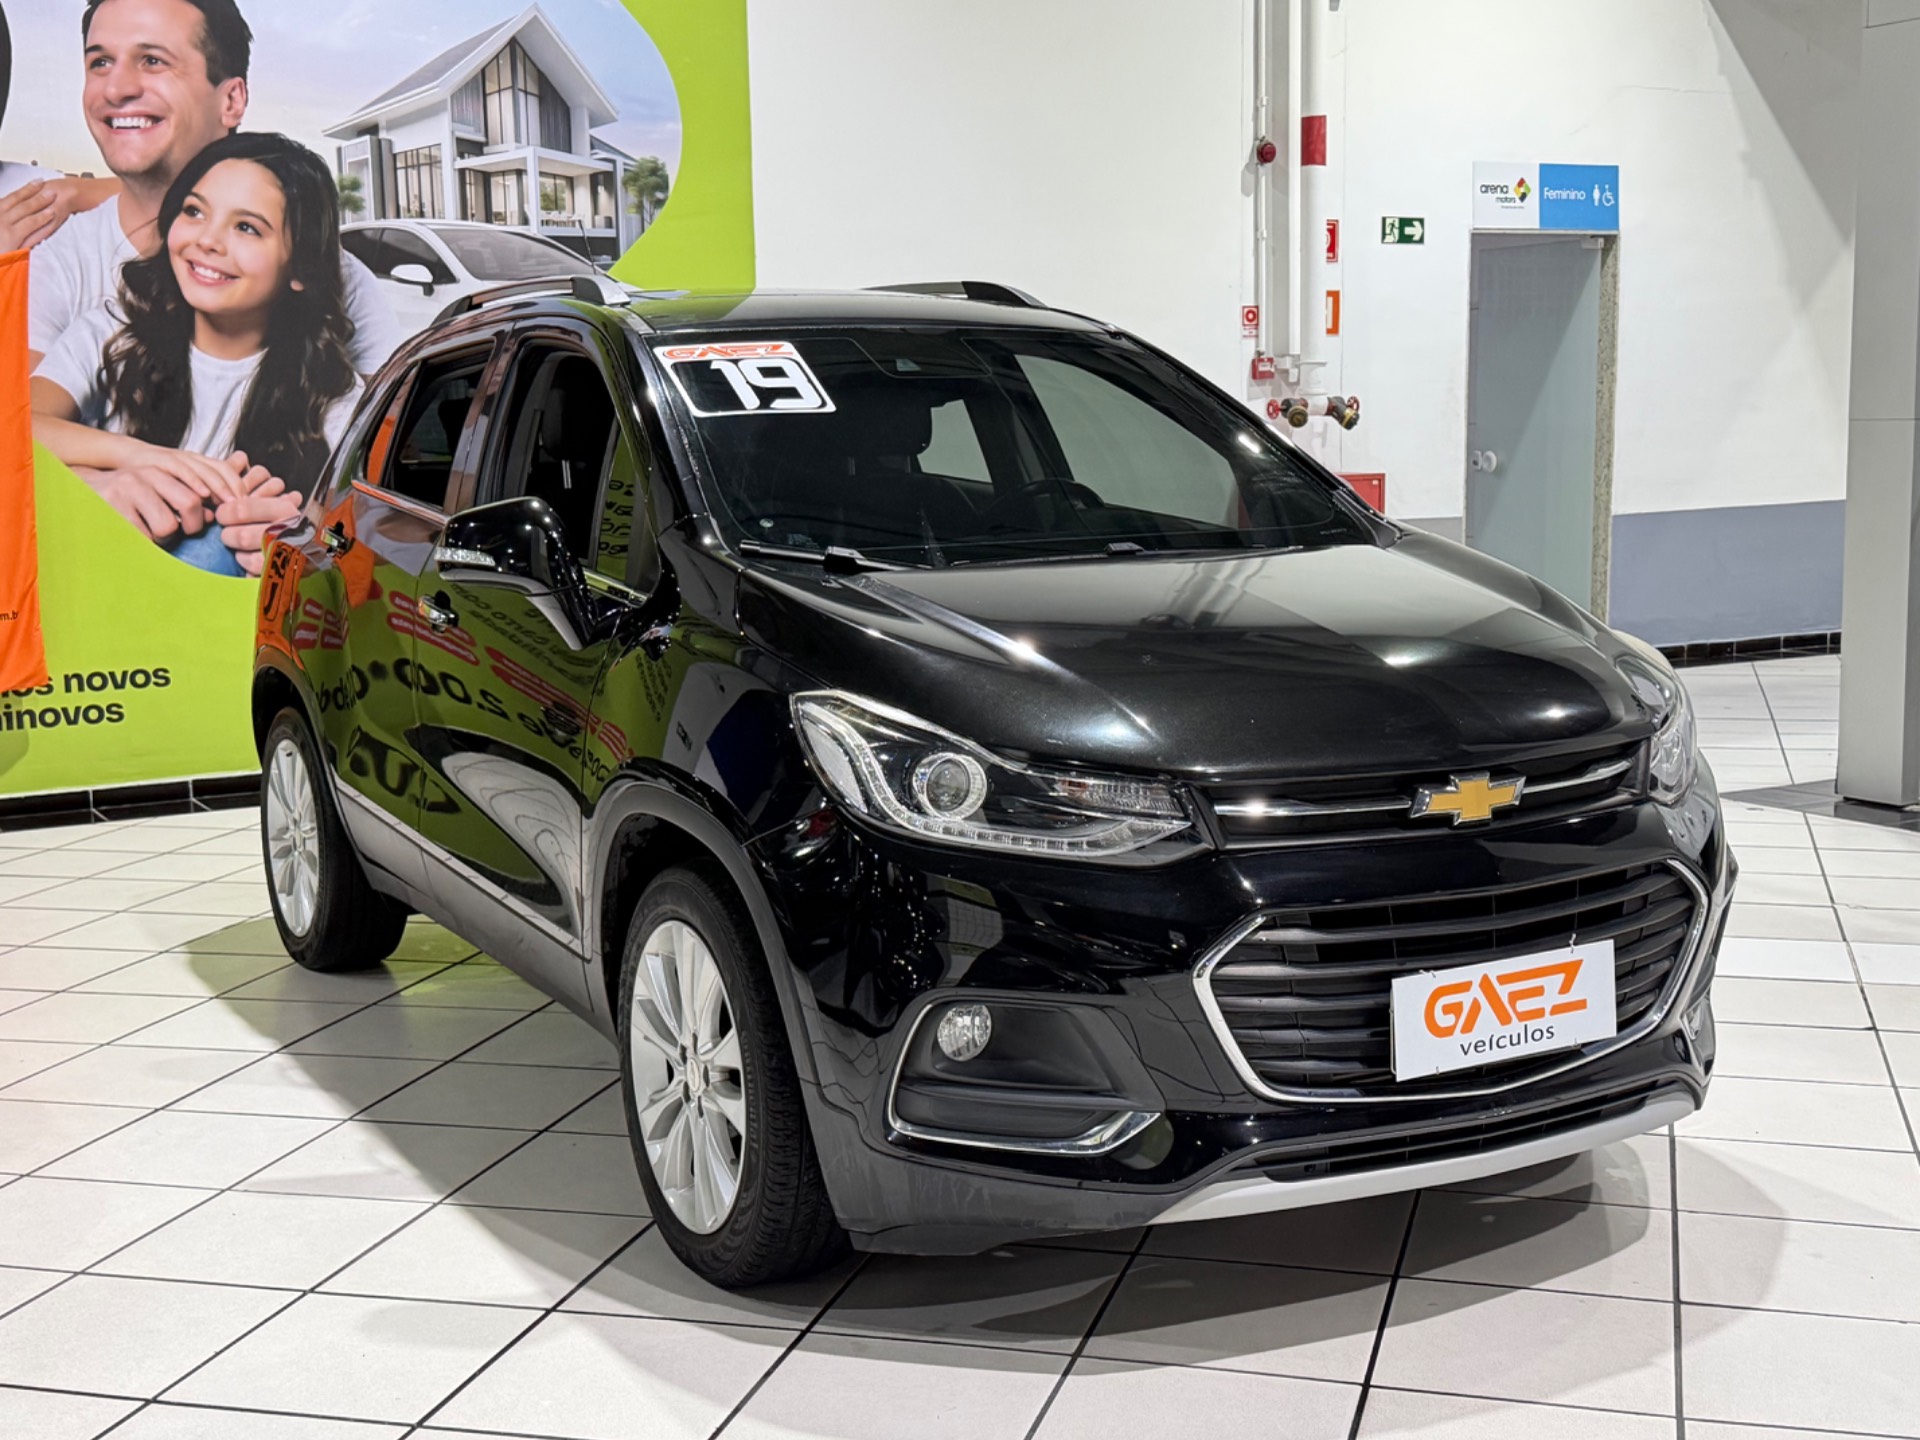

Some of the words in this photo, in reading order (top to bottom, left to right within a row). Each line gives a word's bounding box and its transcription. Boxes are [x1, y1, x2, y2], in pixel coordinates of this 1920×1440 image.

[1480, 184, 1509, 194] arena
[1495, 196, 1516, 204] motors
[1544, 187, 1586, 200] Feminino
[663, 343, 794, 360] GAEZ
[710, 358, 822, 410] 19
[63, 667, 171, 694] novos
[0, 703, 125, 731] inovos
[1423, 959, 1588, 1039] GAEZ
[1460, 1024, 1555, 1056] veículos
